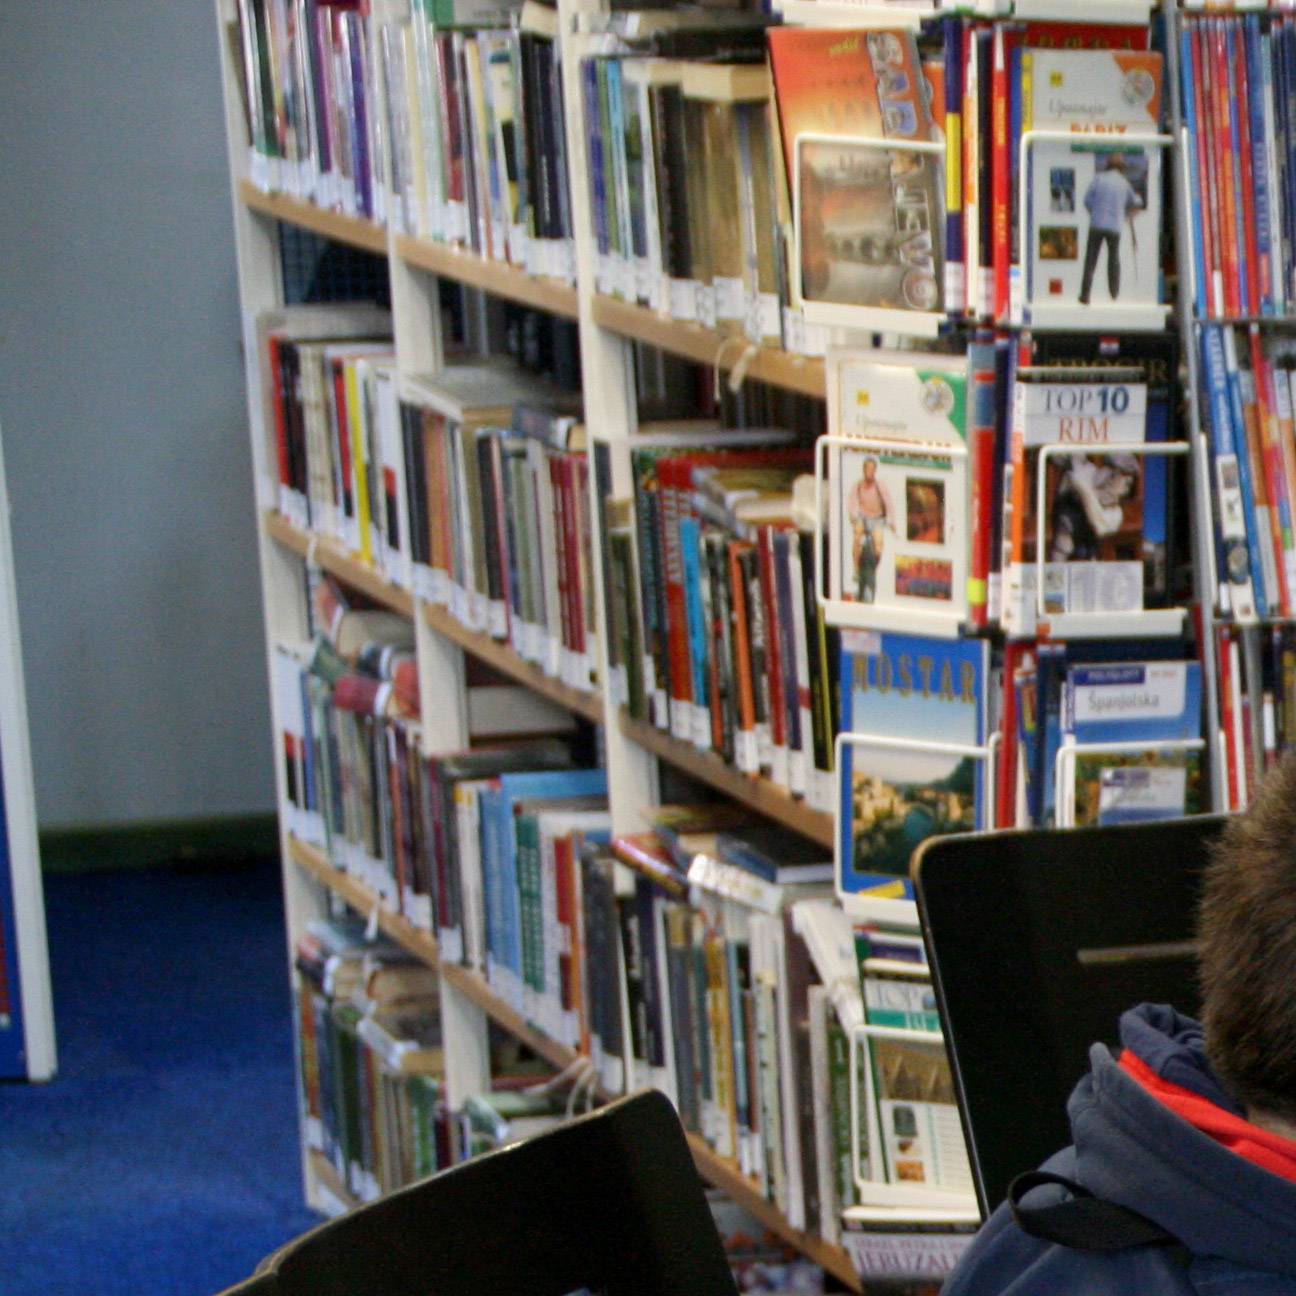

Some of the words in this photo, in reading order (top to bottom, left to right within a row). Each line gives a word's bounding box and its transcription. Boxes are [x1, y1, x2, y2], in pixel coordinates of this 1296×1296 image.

[1041, 387, 1092, 413] TOP
[1097, 385, 1130, 413] 10
[1058, 415, 1110, 443] RIM
[852, 652, 977, 704] MOSTAR
